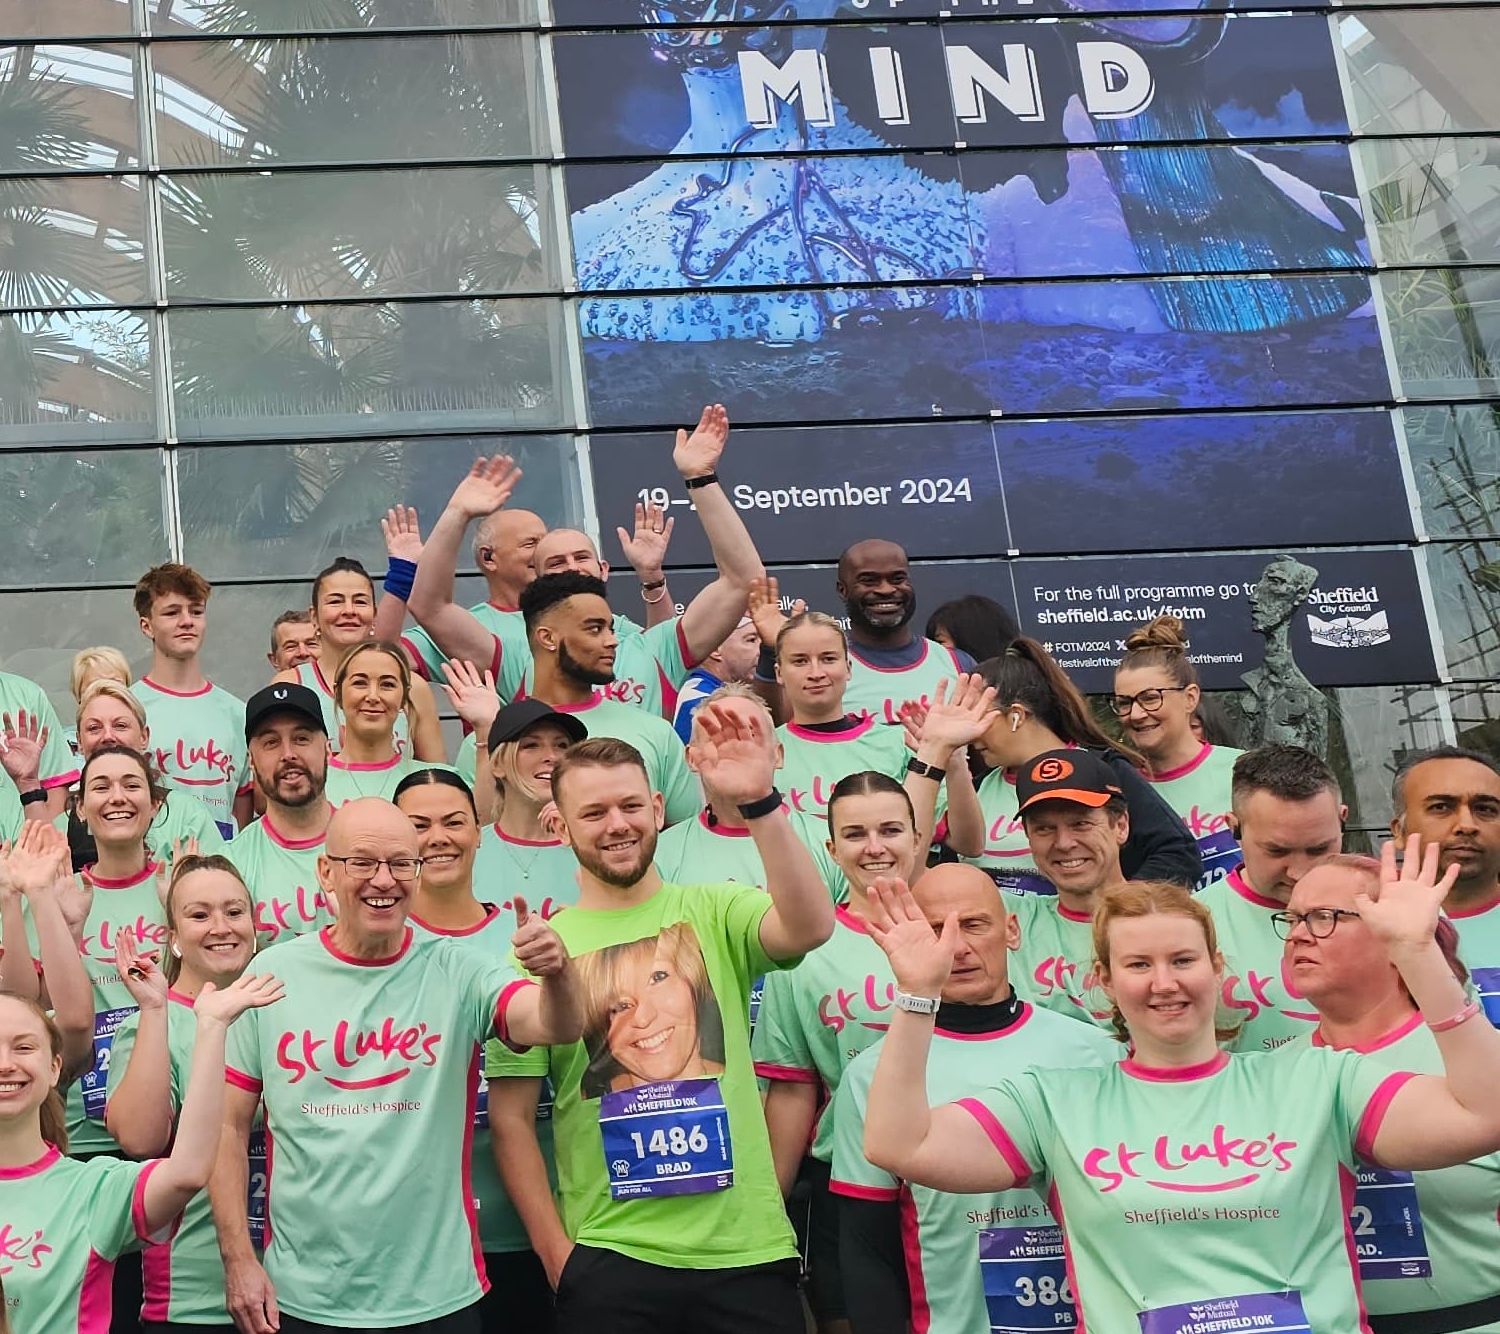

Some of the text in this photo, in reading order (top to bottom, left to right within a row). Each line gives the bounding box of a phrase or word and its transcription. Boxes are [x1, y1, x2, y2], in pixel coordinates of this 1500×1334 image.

[737, 42, 1155, 128] MIND
[734, 478, 972, 514] September 2024
[1034, 586, 1060, 602] For
[1065, 586, 1093, 601] the
[1096, 585, 1121, 600] full
[1124, 584, 1215, 603] programme
[1219, 583, 1239, 600] go
[1308, 587, 1379, 604] Sheffield
[1037, 605, 1206, 624] sheffield.ac.uk/fotm
[1320, 604, 1371, 615] City Council
[176, 739, 235, 782] Luke's
[1222, 971, 1275, 1022] St
[277, 1017, 442, 1084] St Luke's
[300, 1099, 421, 1117] Sheffield's Hospice
[638, 1097, 698, 1113] SHEFFIELD 10K
[631, 1125, 708, 1159] 1486
[1084, 1124, 1297, 1192] St Luke's
[656, 1162, 691, 1175] BRAD
[967, 1205, 1039, 1223] Sheffield's
[1124, 1205, 1280, 1225] Sheffield's Hospice
[1015, 1275, 1076, 1307] 386
[1204, 1300, 1239, 1312] Sheffield
[1205, 1310, 1236, 1320] Mutual
[1055, 1312, 1072, 1324] PB
[1194, 1315, 1274, 1334] SHEFFIELD 10K
